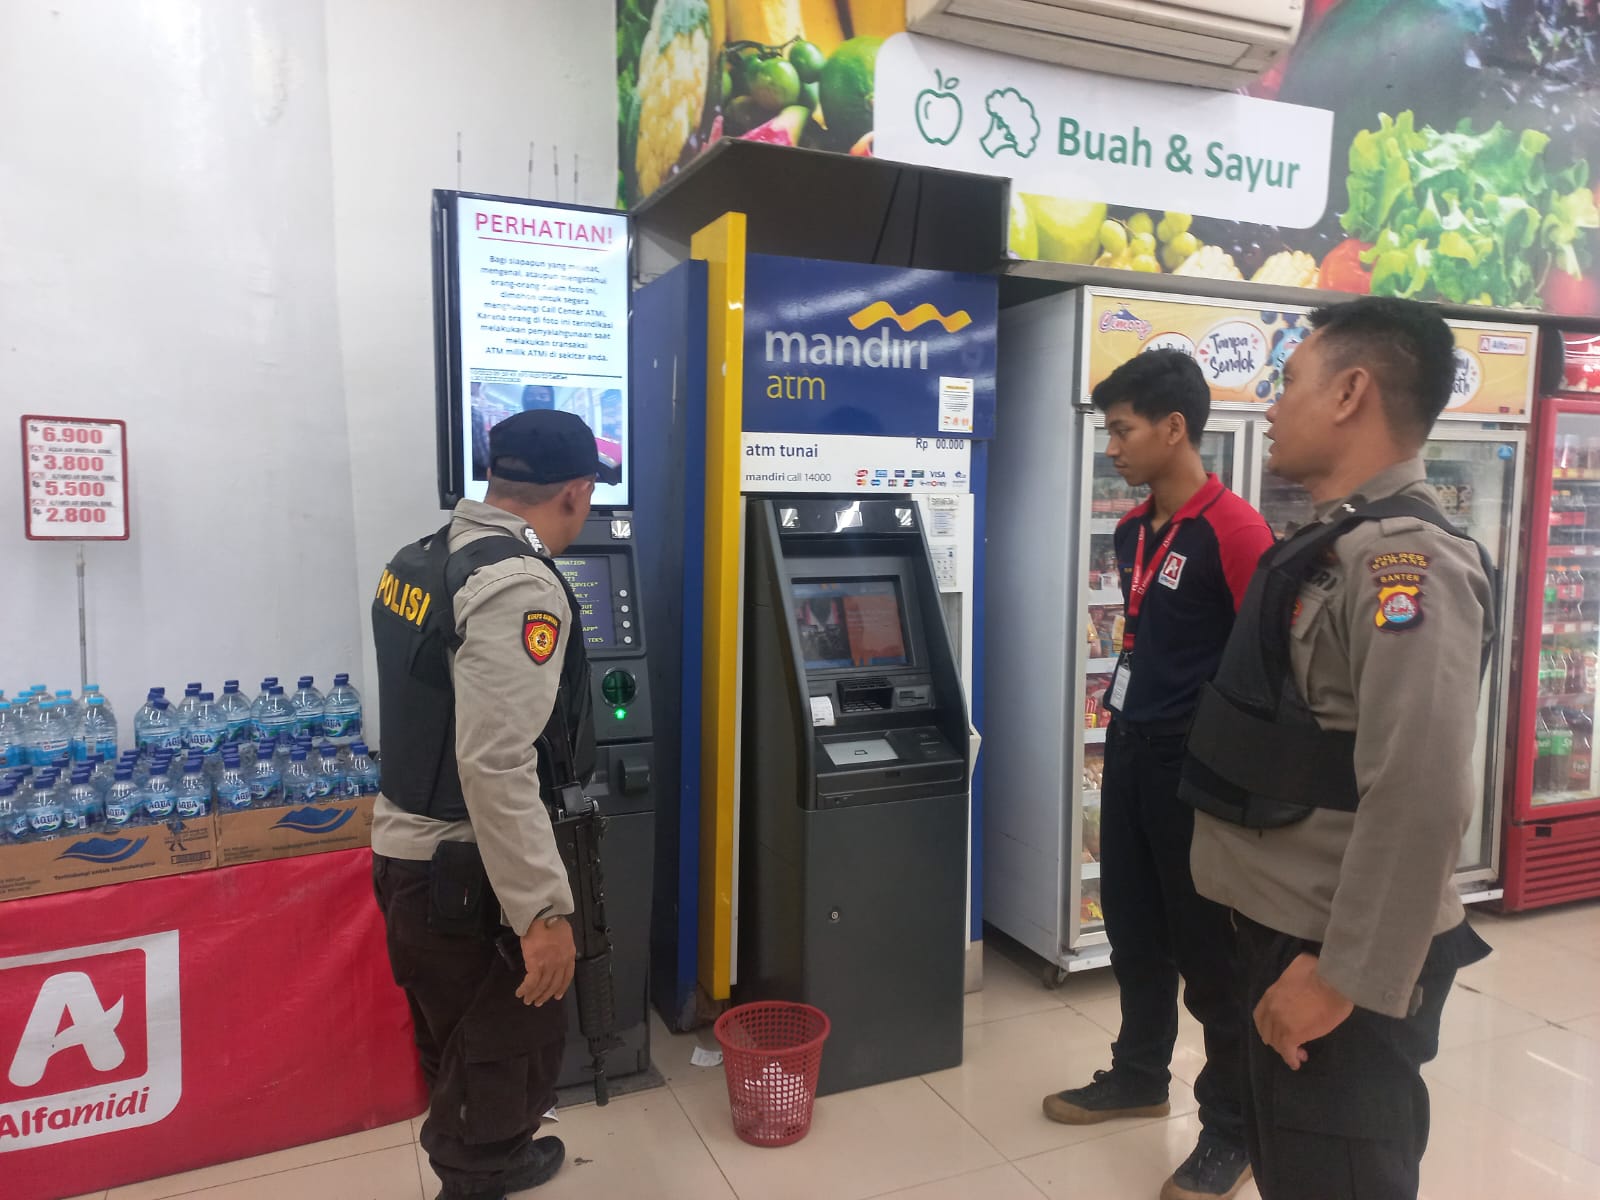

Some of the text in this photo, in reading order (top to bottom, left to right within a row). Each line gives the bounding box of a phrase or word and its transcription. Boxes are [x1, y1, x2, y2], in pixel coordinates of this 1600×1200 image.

[1058, 116, 1301, 193] Buah & Sayur
[475, 212, 613, 244] PERHATIAN!
[489, 256, 506, 265] Bagi
[509, 258, 546, 267] siapapun
[548, 262, 566, 271] yang
[491, 280, 540, 291] orang-orang
[568, 285, 584, 293] foto
[564, 297, 589, 305] segera
[541, 305, 556, 313] Call
[558, 306, 584, 316] Center
[508, 315, 531, 324] orang
[542, 316, 559, 325] foto
[561, 318, 571, 326] ini
[572, 319, 613, 329] terindikasi
[480, 324, 611, 340] melakukan penyalahgunaan saat
[506, 337, 588, 349] melakukan transaksi
[764, 326, 929, 370] mandiri
[1209, 333, 1249, 354] Tampa
[485, 346, 503, 354] ATM
[559, 352, 585, 360] sekitar
[588, 354, 608, 362] anda.
[1209, 350, 1255, 379] Sendok
[766, 374, 826, 401] atm
[43, 427, 103, 444] 6.900
[746, 443, 818, 458] atm tunai
[915, 438, 929, 451] Rp
[43, 455, 104, 471] 3.800
[745, 472, 832, 482] mandiri call 14000
[45, 481, 105, 496] 5.500
[46, 507, 106, 522] 2.800
[1380, 573, 1421, 583] BANTEN
[376, 568, 431, 627] POLISI
[190, 734, 213, 746] AQUA
[150, 800, 171, 809] AQUA
[33, 813, 60, 825] AQUA
[0, 1086, 150, 1139] Alfamidi
